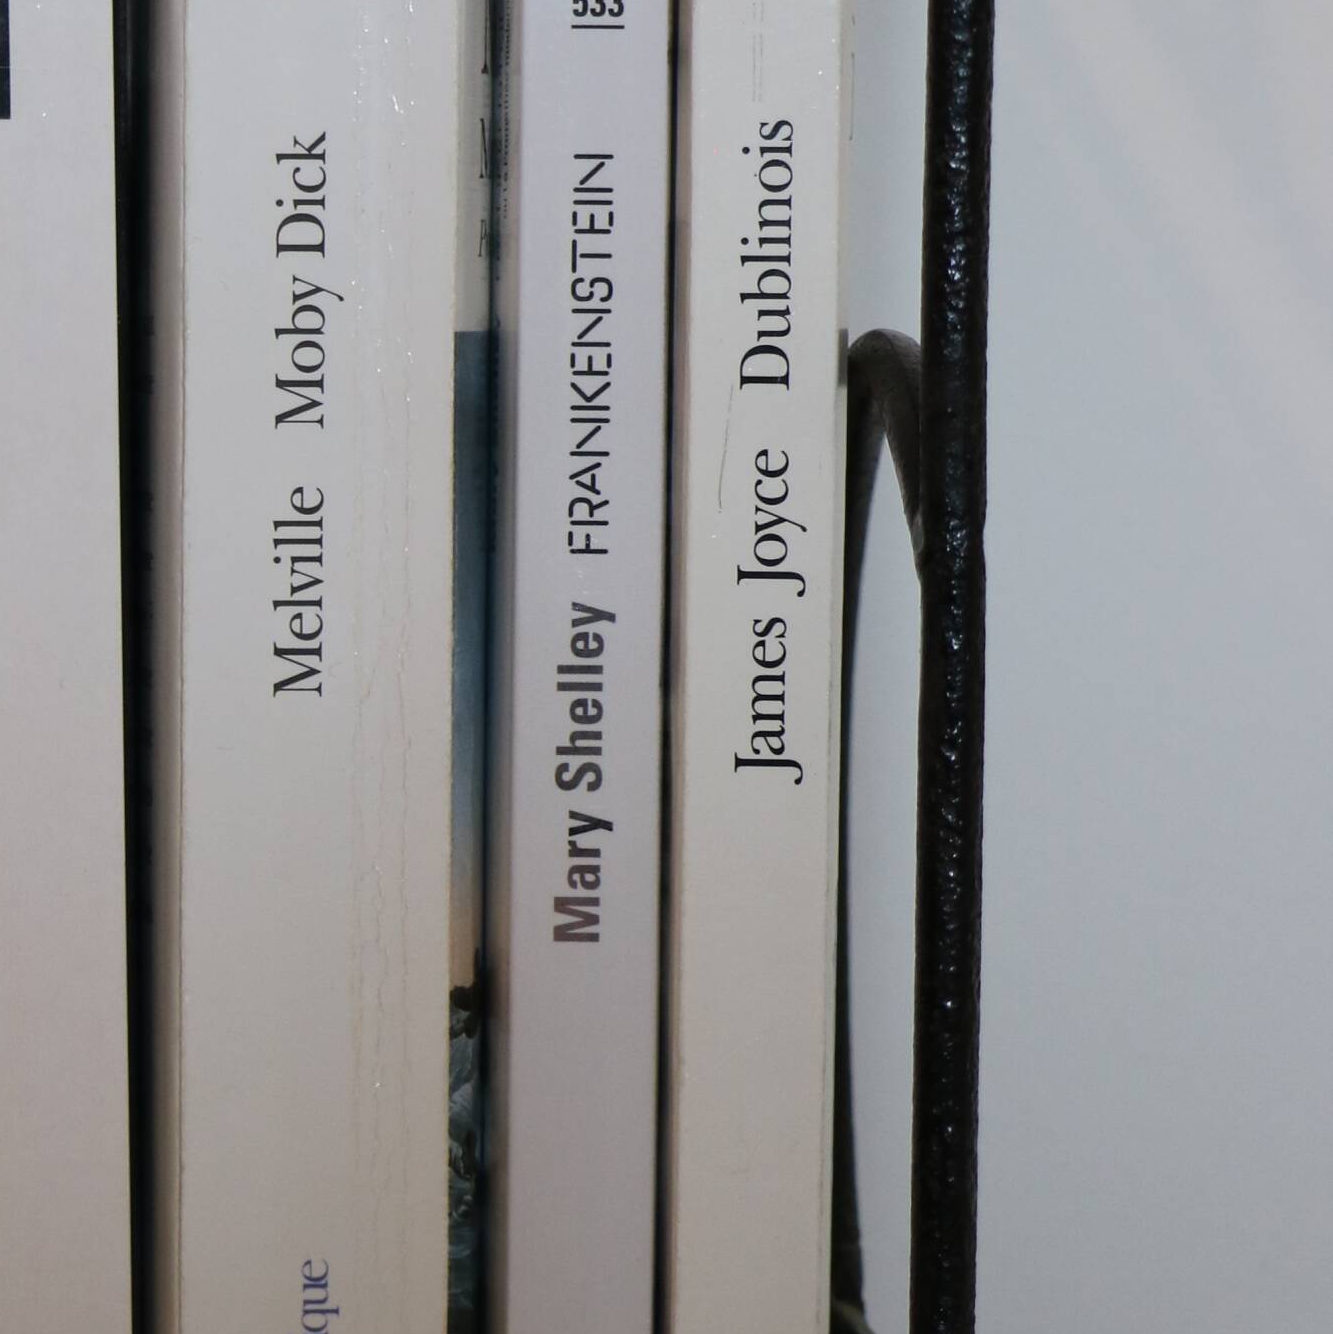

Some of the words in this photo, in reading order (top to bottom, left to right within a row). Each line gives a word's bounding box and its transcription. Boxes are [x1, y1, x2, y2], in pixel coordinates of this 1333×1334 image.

[275, 130, 328, 260] Dick
[738, 119, 794, 392] Dublinois
[273, 274, 345, 430] Moby
[567, 153, 615, 556] FRANKENSTEIN
[271, 485, 326, 698] Melville
[736, 448, 808, 598] Joyce
[554, 601, 617, 793] Shelley
[733, 616, 804, 786] James
[552, 809, 614, 944] Mary
